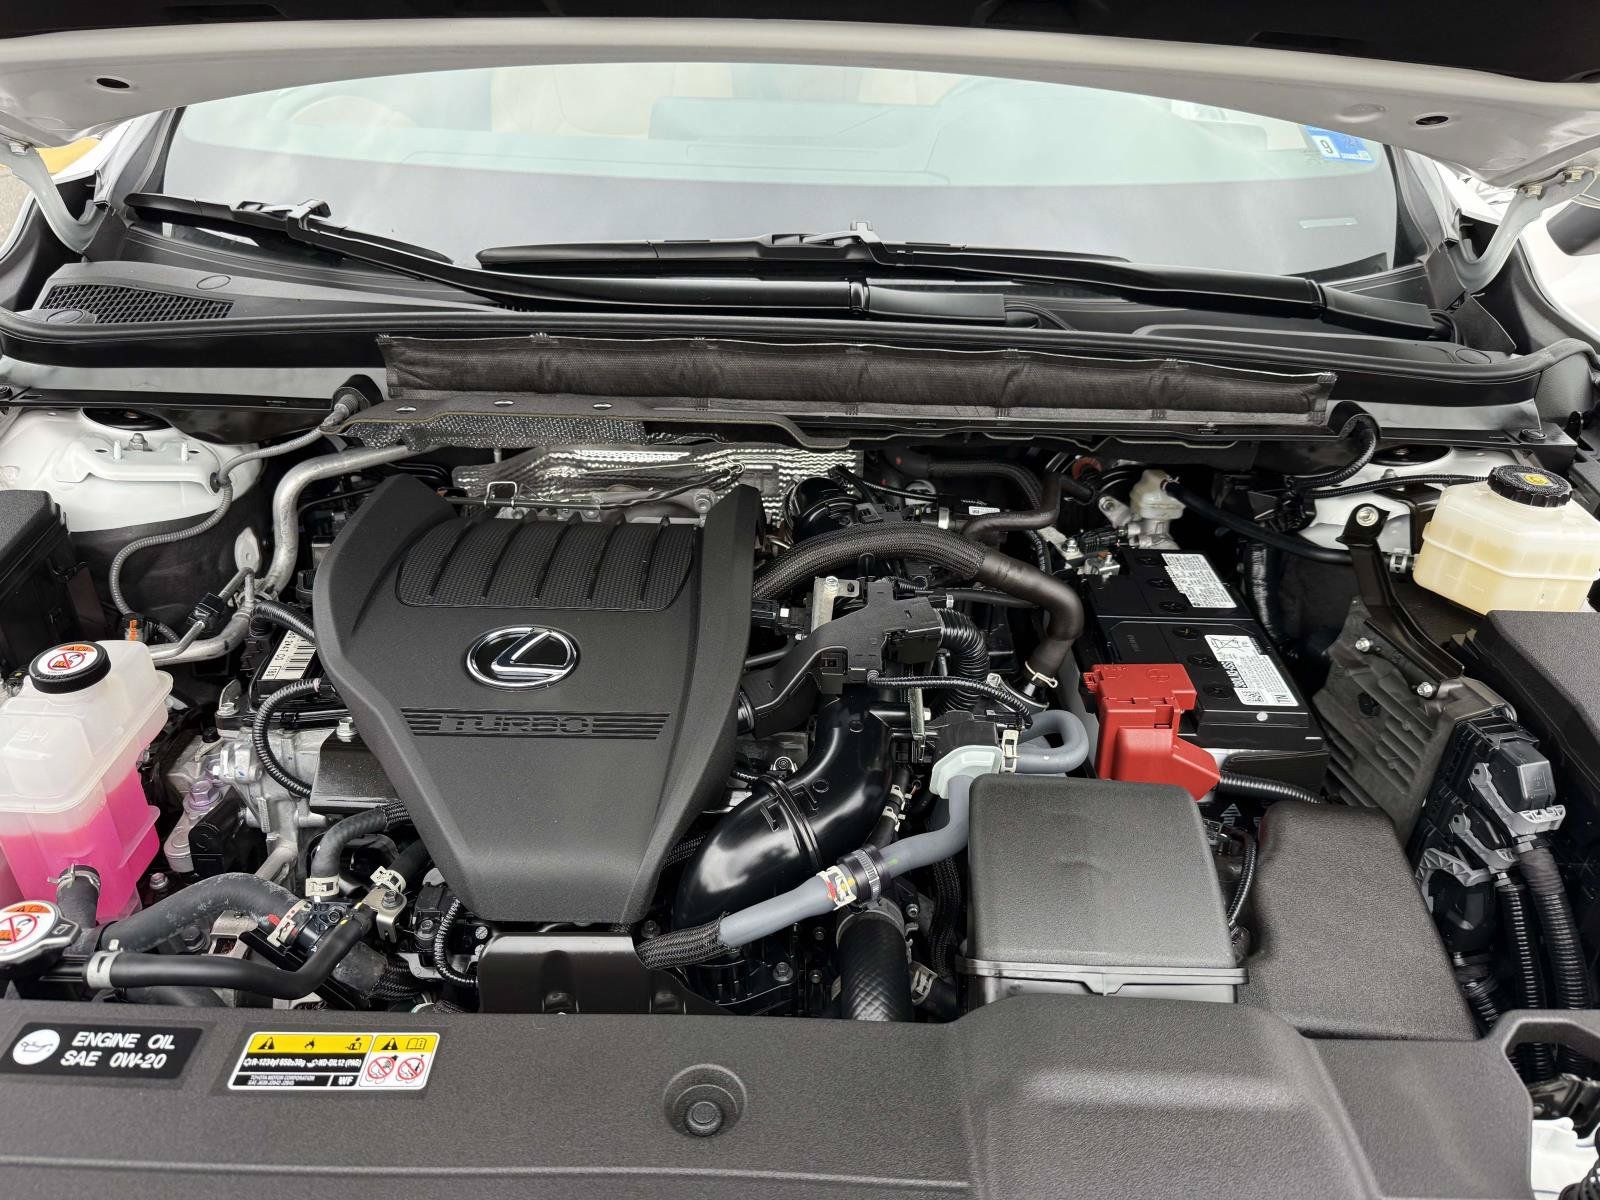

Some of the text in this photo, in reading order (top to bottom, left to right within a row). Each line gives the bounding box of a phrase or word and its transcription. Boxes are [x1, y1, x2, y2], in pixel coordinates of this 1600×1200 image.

[439, 714, 592, 735] TURBO
[72, 1031, 176, 1050] ENGINE OIL
[60, 1050, 168, 1069] SAE 0W-20
[338, 1076, 354, 1085] WF
